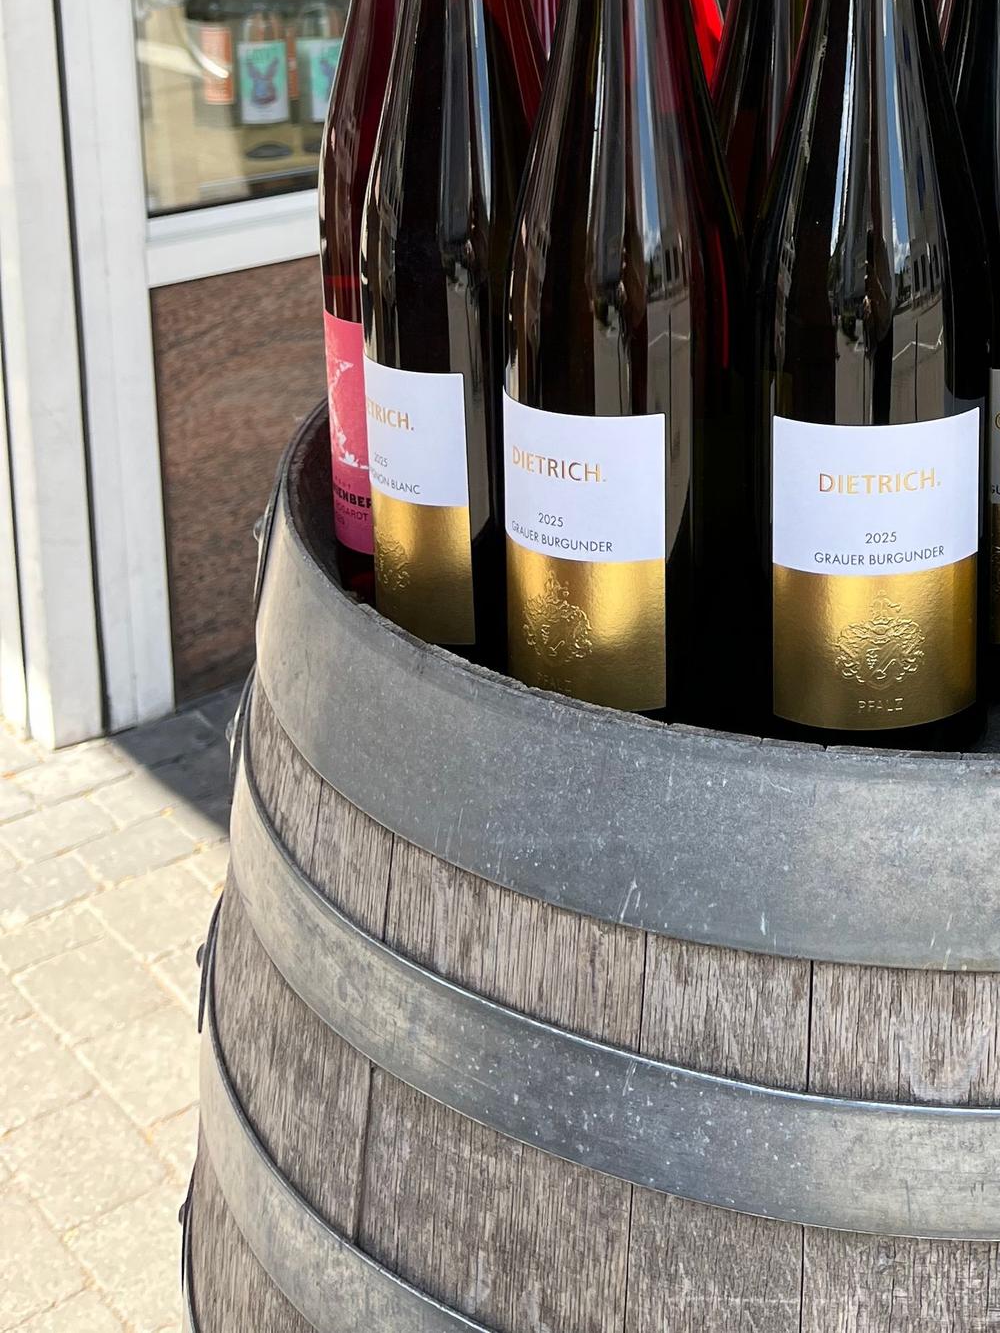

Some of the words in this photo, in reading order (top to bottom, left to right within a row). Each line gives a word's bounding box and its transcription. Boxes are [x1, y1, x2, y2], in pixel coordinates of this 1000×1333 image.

[512, 445, 607, 483] DIETRICH.
[391, 479, 421, 495] BLANC
[819, 467, 941, 494] DIETRICH.
[538, 512, 564, 528] 2025
[511, 520, 539, 542] GRAUER
[541, 534, 613, 553] BURGUNDER
[865, 531, 897, 544] 2025
[814, 551, 865, 567] GRAUER
[869, 545, 945, 566] BURGUNDER
[858, 698, 904, 714] PFALZ
